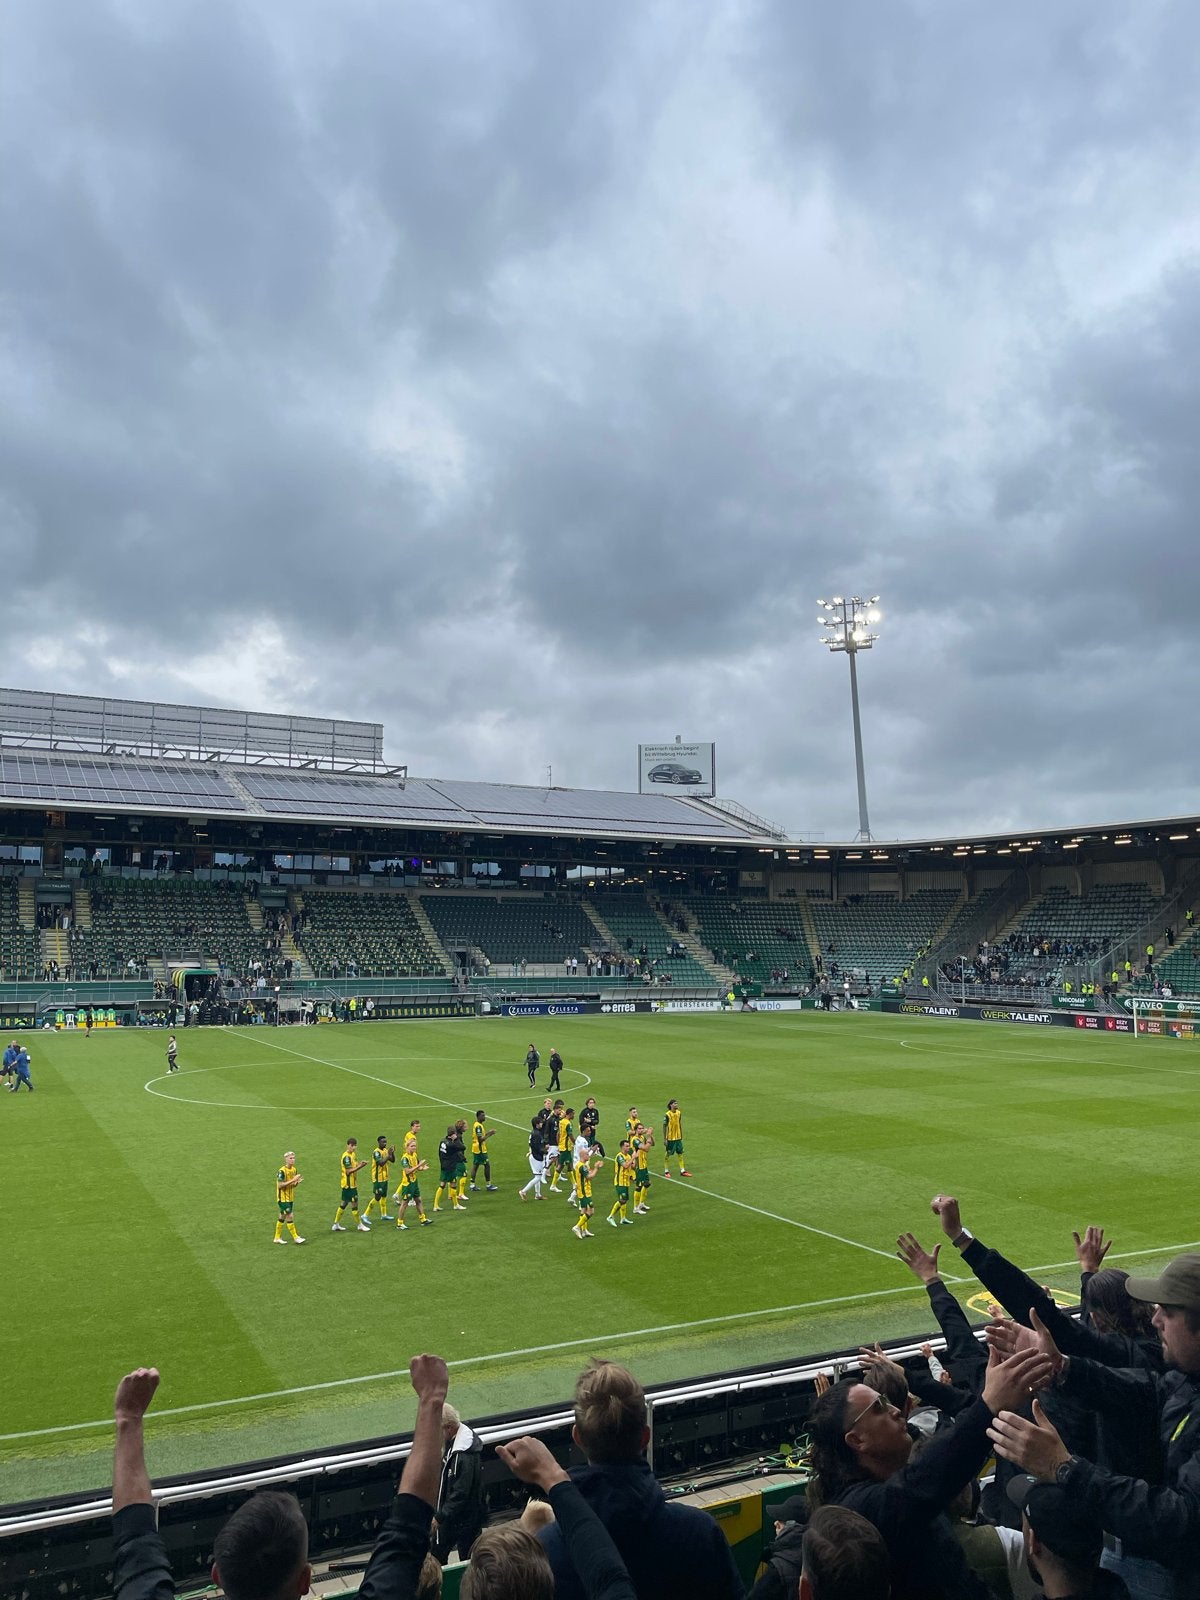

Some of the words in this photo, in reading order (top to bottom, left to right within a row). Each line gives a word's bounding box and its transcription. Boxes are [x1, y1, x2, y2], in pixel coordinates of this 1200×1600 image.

[509, 1006, 540, 1014] ZELESTA
[548, 1005, 578, 1014] ZELESTA
[612, 1003, 635, 1012] errea
[760, 1001, 781, 1010] wblo
